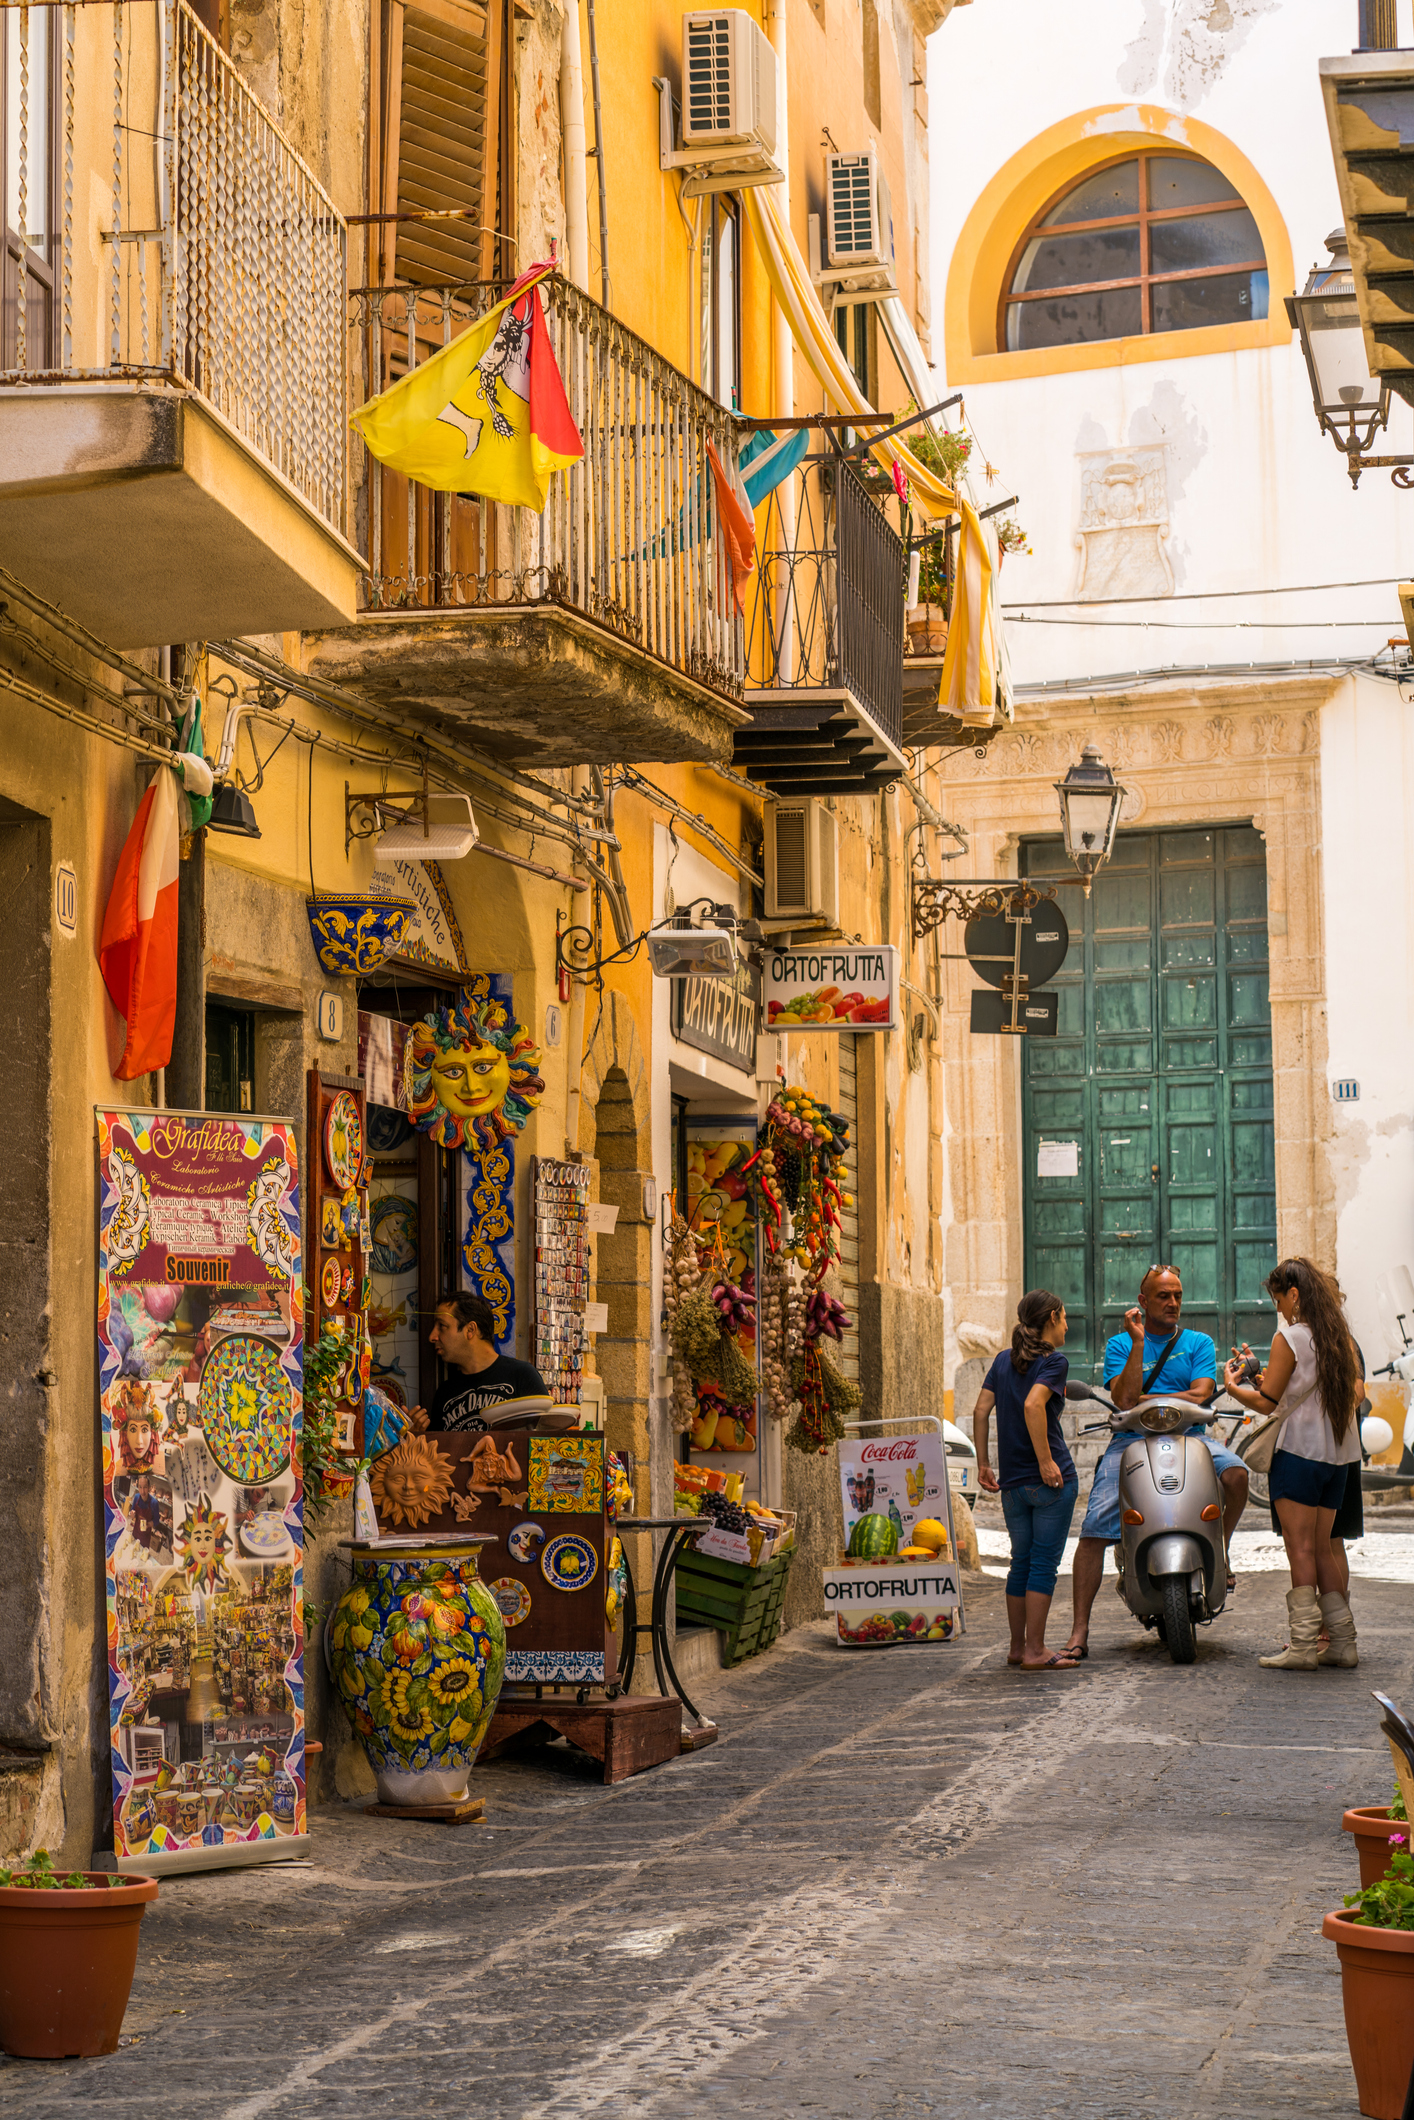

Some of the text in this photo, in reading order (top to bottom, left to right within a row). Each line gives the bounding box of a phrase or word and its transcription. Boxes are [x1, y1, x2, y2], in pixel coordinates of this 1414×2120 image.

[61, 879, 74, 919] 10
[772, 954, 886, 982] ORTOFRUTTA
[328, 999, 336, 1032] 8
[550, 1010, 556, 1040] 6
[683, 977, 756, 1059] ORTOFRUTTA
[1338, 1082, 1357, 1098] 111
[152, 1117, 242, 1161] Grafidea
[171, 1159, 220, 1175] Laboratorio
[150, 1170, 246, 1195] Ceramiche Artistiche
[149, 1196, 248, 1212] Laboratorio Ceramica Tipica
[149, 1208, 175, 1221] Typical
[176, 1209, 204, 1221] Ceramic
[210, 1211, 249, 1223] Workshop
[150, 1221, 189, 1234] Ceramique
[190, 1222, 214, 1235] typique
[220, 1223, 247, 1233] Atelier
[151, 1231, 187, 1244] Typischen
[189, 1232, 217, 1243] Keramik
[223, 1232, 246, 1244] Labor
[167, 1255, 230, 1282] Souvenir
[110, 1278, 166, 1289] www.grafidee.it
[215, 1280, 290, 1293] grafiche@grafidee.it
[442, 1400, 468, 1431] JACK
[861, 1439, 919, 1463] Coca-Cola
[824, 1577, 957, 1600] ORTOFRUTTA
